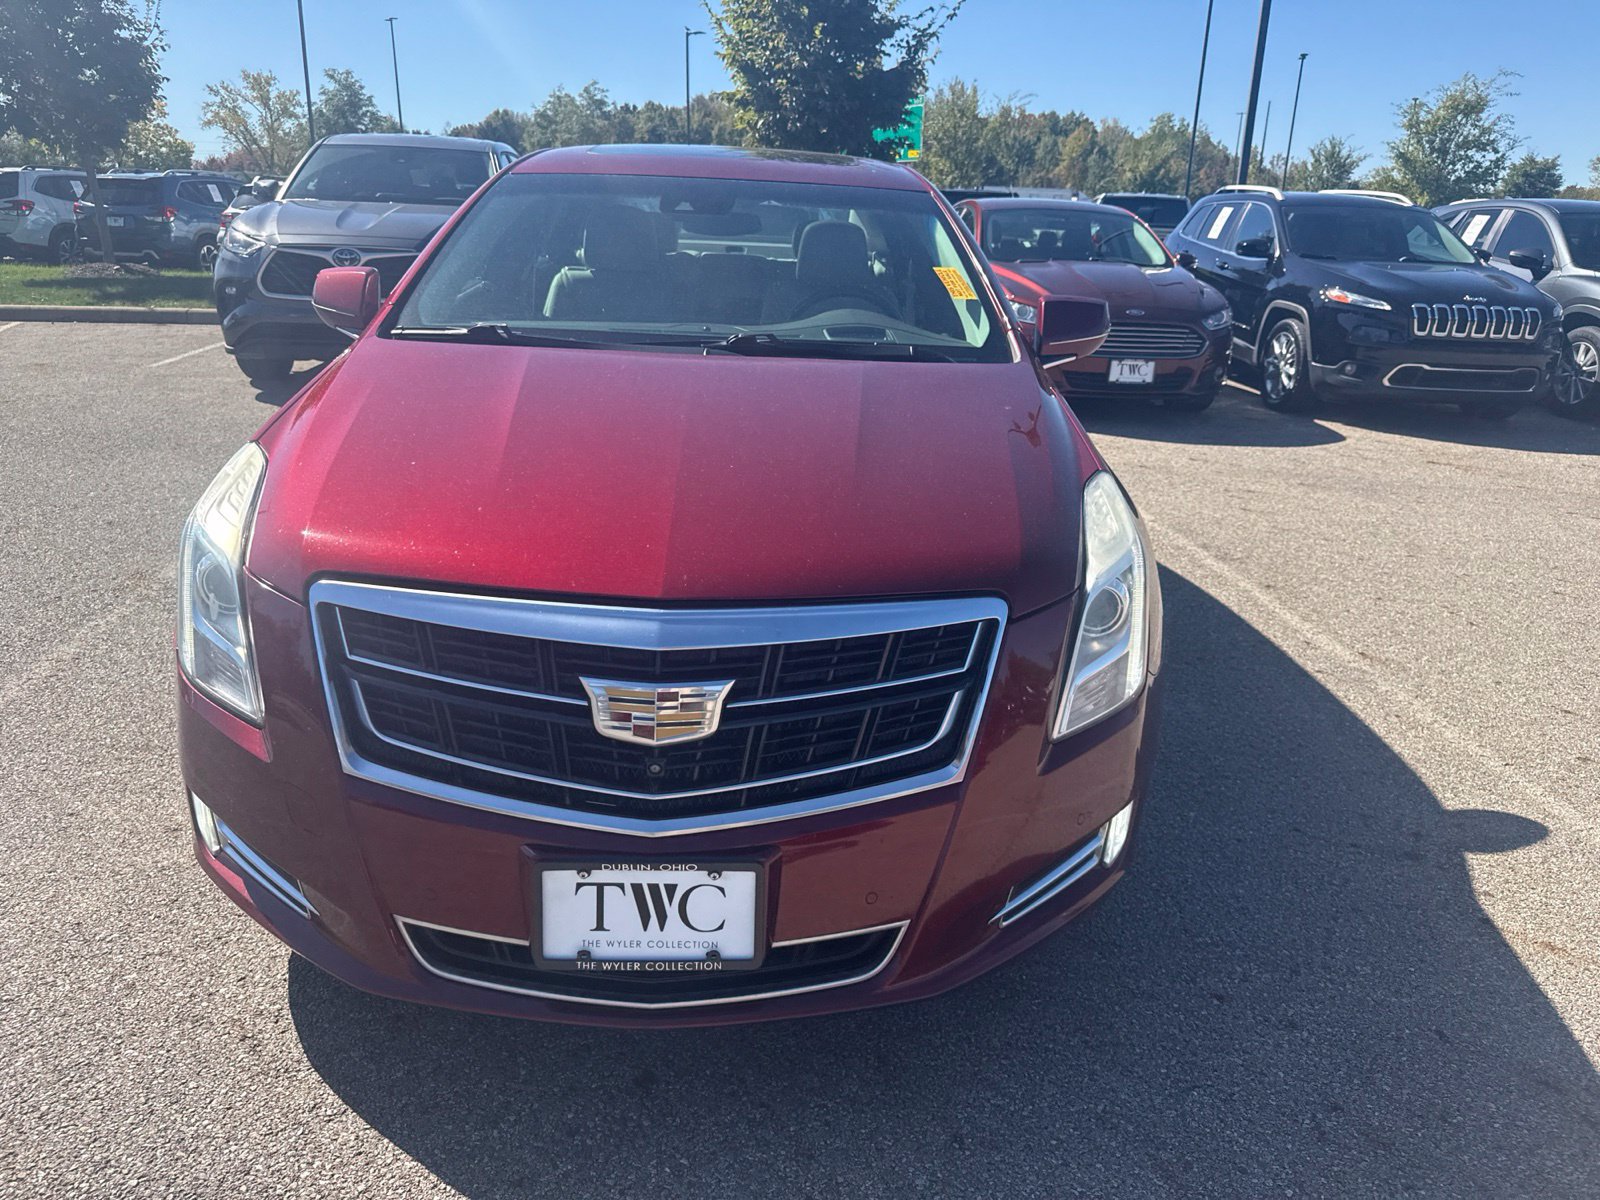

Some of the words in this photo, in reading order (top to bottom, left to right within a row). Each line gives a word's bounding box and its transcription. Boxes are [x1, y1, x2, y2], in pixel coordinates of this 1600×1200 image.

[1117, 363, 1149, 376] TWC
[659, 863, 698, 872] OHIO
[574, 882, 727, 933] TWC
[581, 939, 601, 949] THE
[606, 939, 642, 949] WYLER
[646, 939, 719, 949] COLLECTION
[576, 961, 597, 971] THE
[601, 961, 641, 971] WYLER
[645, 961, 722, 971] COLLECTION
